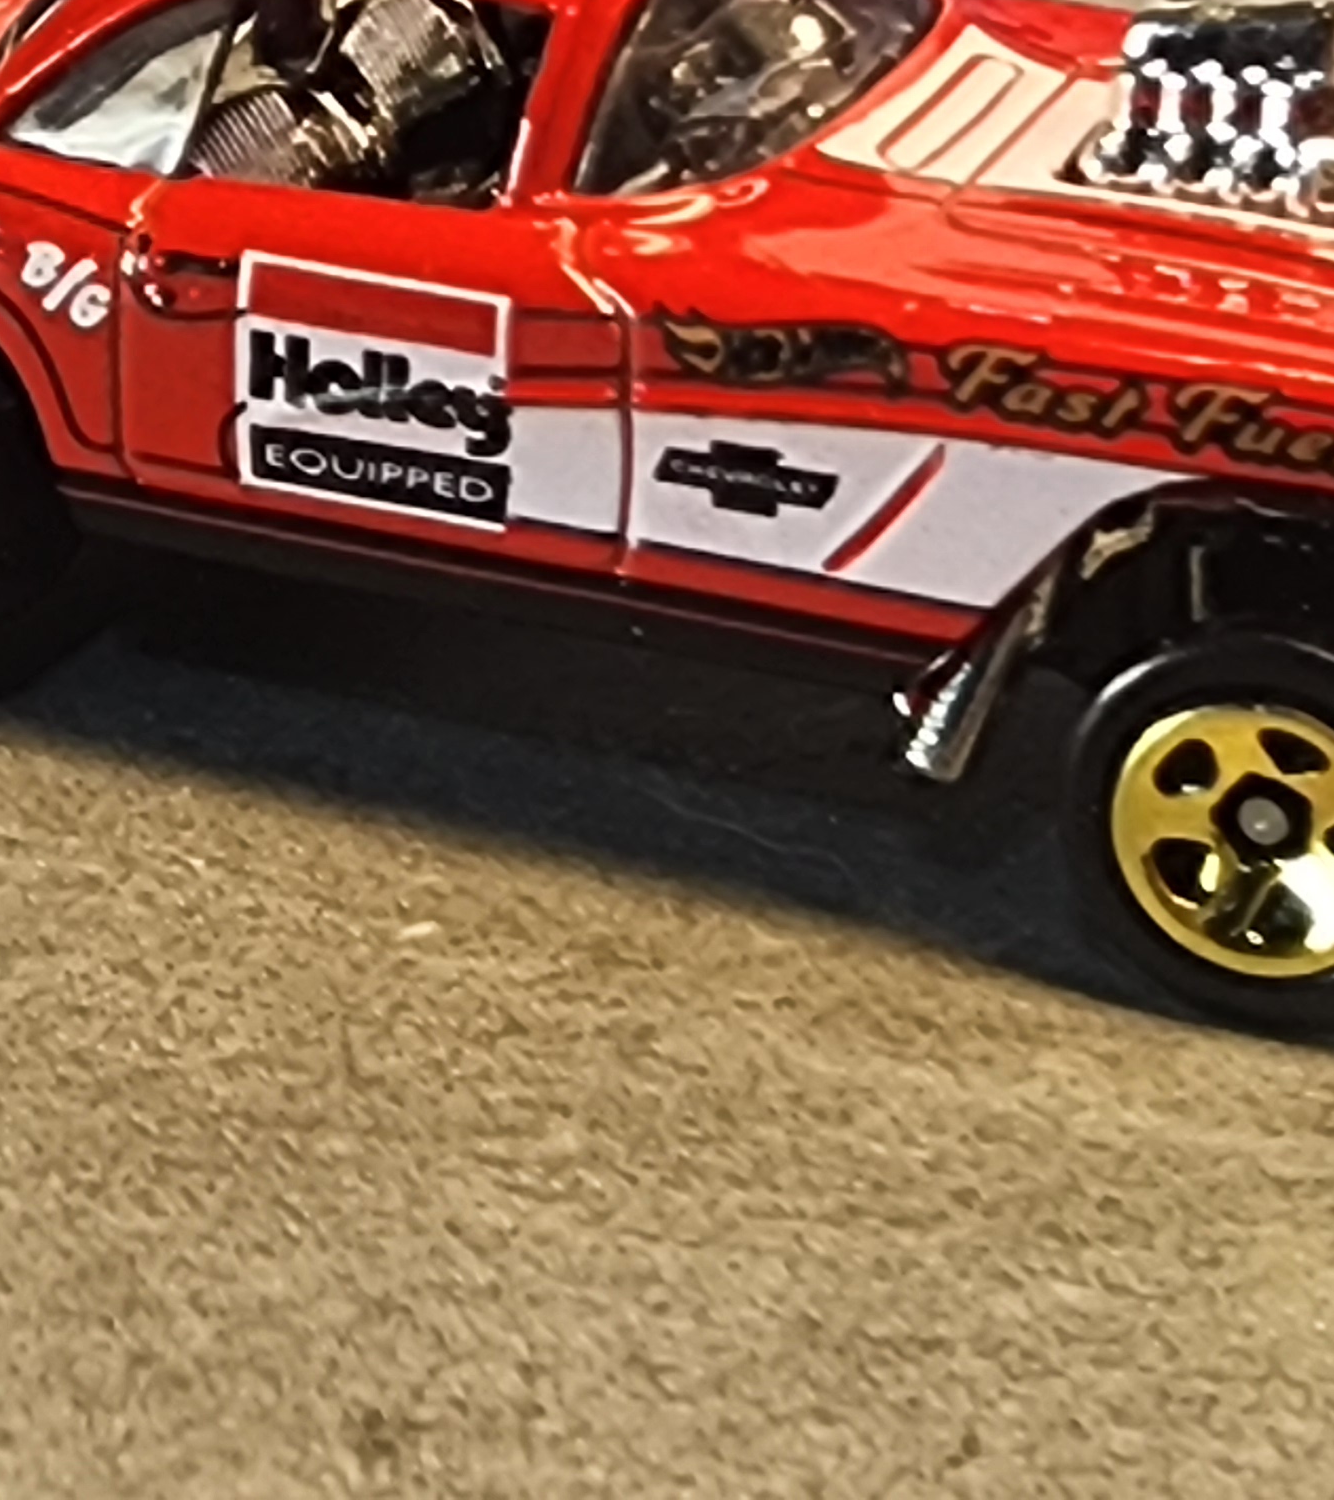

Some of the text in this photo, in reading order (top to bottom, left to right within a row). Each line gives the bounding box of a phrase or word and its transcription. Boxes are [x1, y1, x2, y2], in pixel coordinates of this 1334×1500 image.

[248, 329, 513, 457] Holley
[946, 344, 1140, 429] Fast
[265, 443, 494, 502] EQUIPPED
